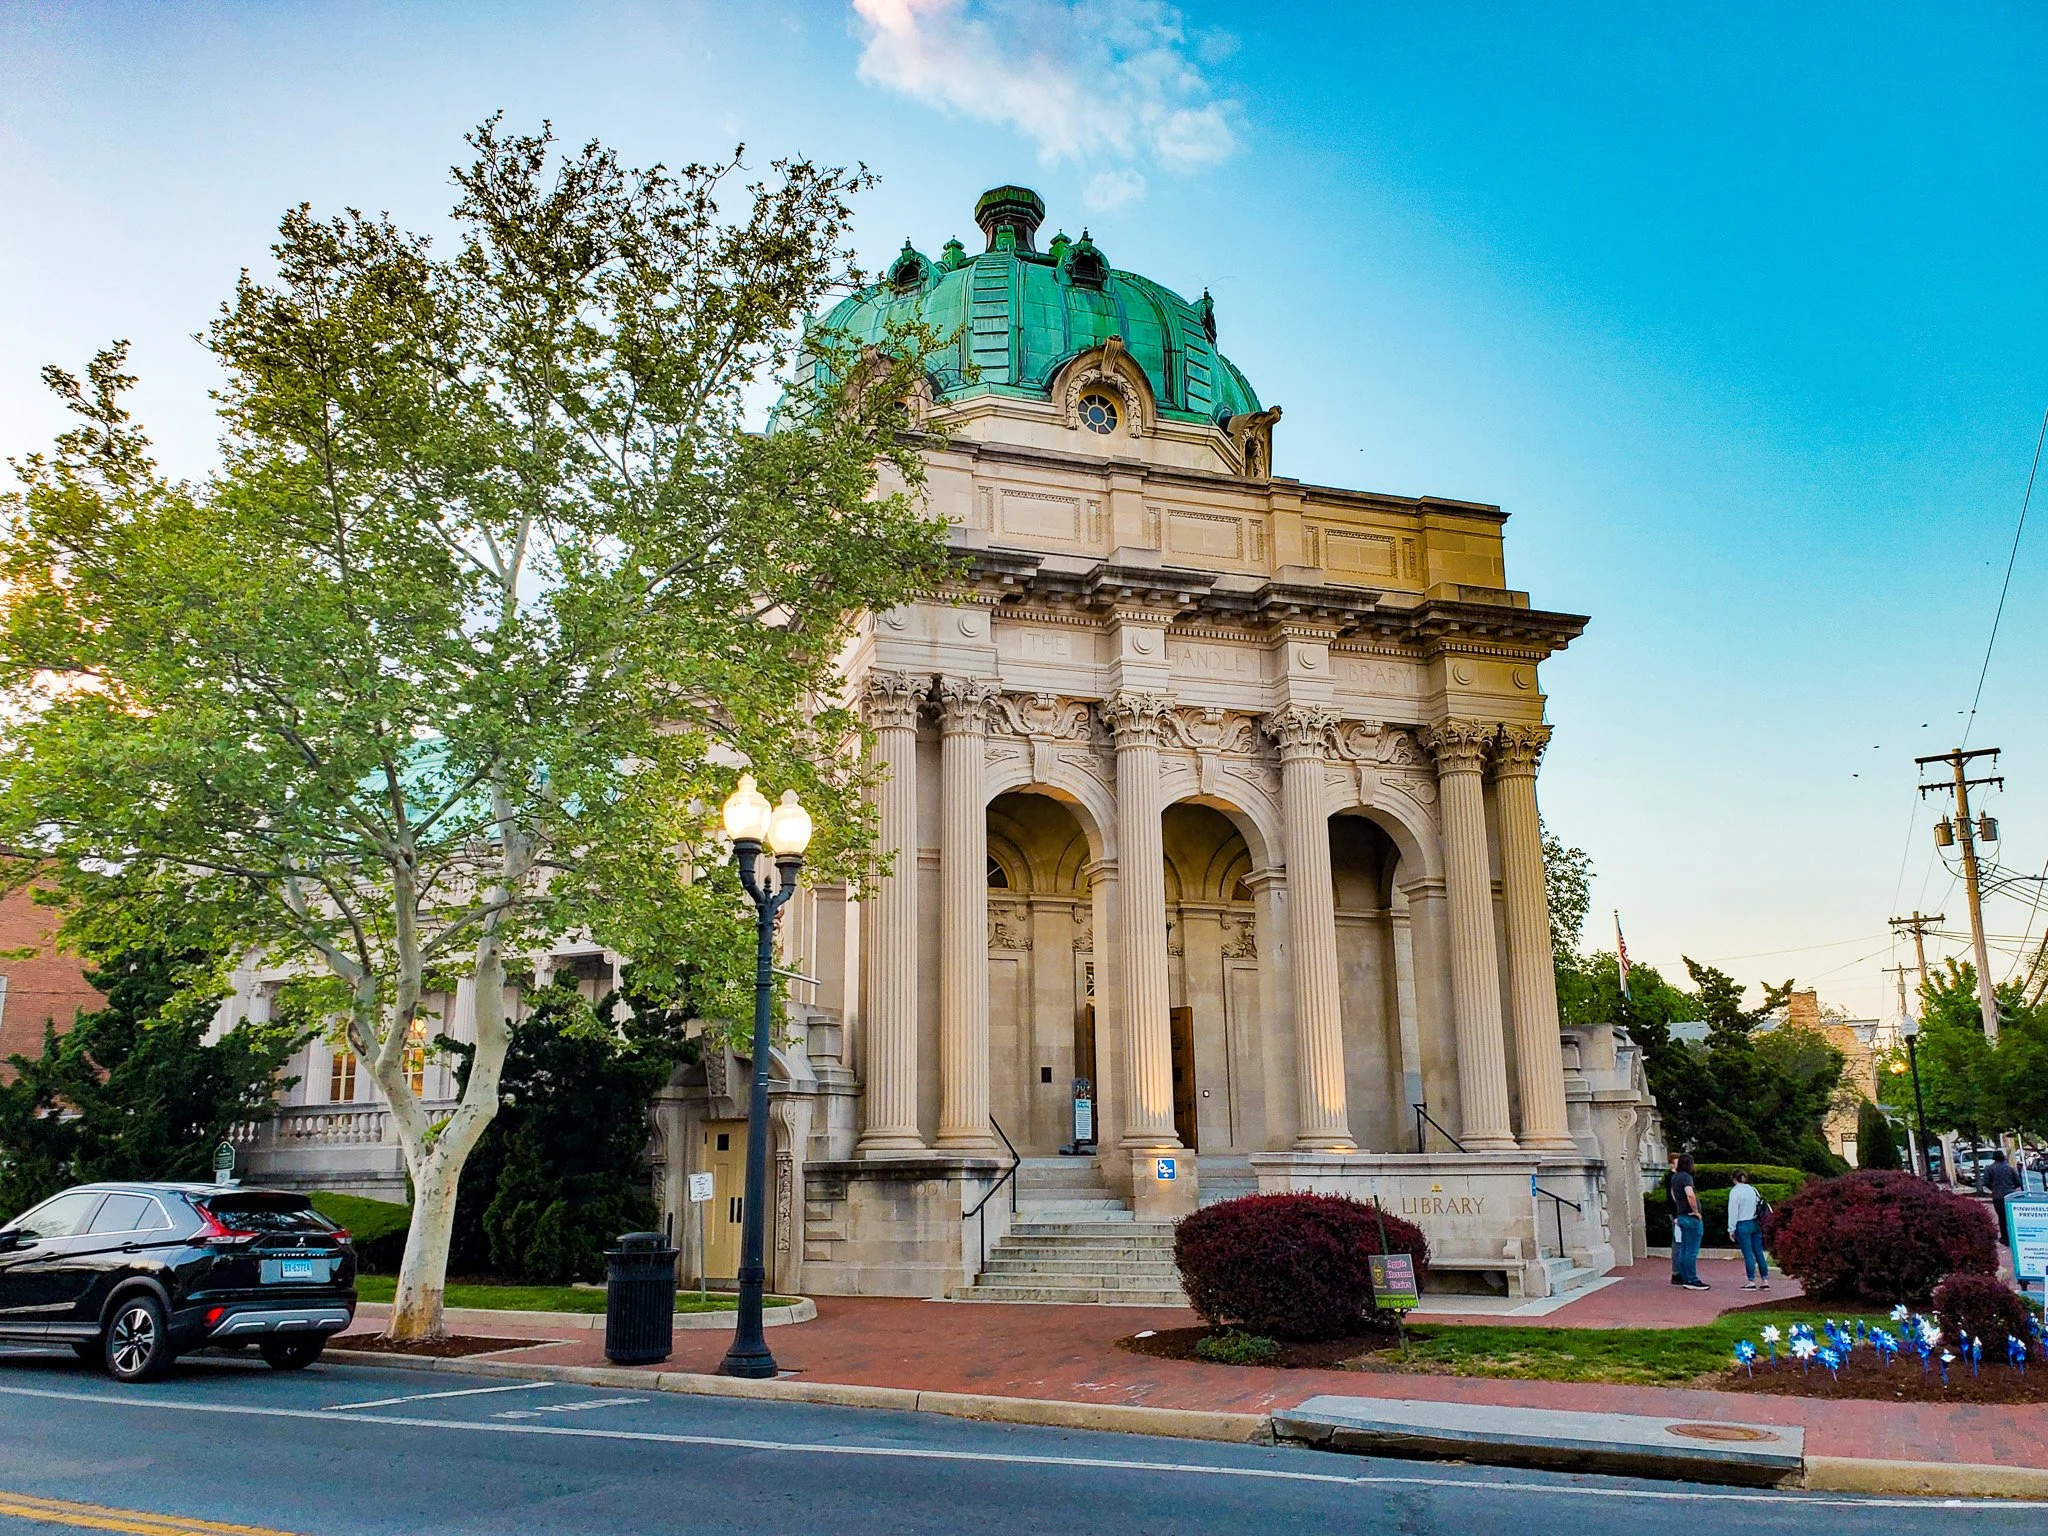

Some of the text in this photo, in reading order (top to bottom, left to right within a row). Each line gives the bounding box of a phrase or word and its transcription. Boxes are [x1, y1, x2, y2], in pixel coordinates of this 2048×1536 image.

[1027, 632, 1068, 656] THE
[1401, 1197, 1485, 1215] LIBRARY
[1387, 1260, 1407, 1270] Apple
[1386, 1270, 1412, 1279] Blossom
